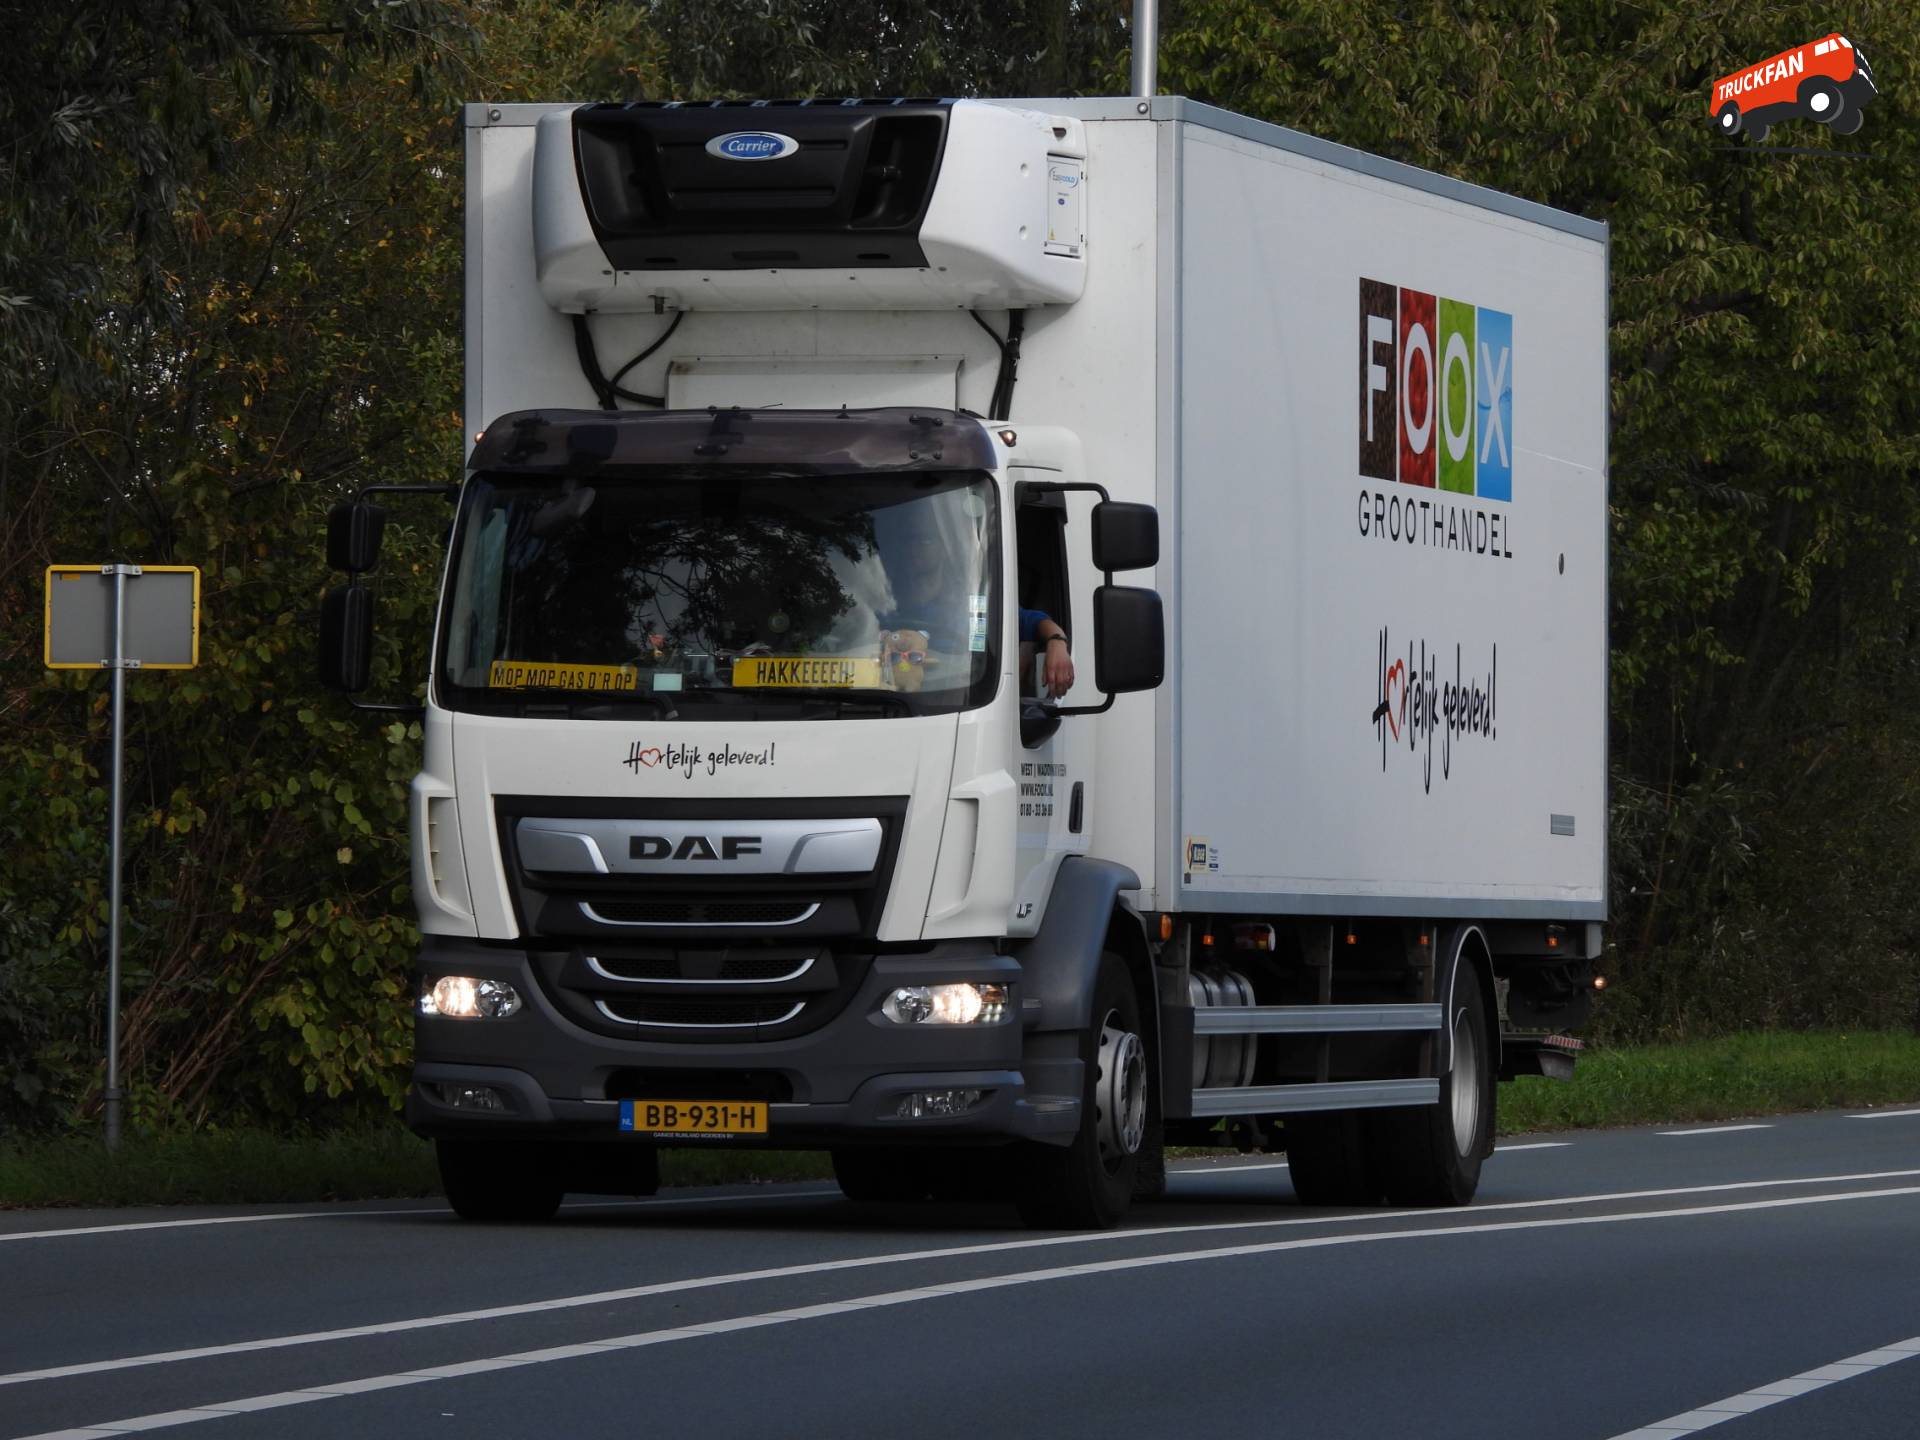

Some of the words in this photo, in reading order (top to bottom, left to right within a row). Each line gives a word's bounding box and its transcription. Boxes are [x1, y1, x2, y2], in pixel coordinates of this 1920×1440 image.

[728, 140, 776, 151] Carrier
[1367, 315, 1510, 468] FOOX
[1359, 489, 1512, 558] GROOTHANDEL
[494, 667, 522, 686] MOP
[527, 668, 555, 687] MOP
[560, 670, 584, 689] GAS
[1443, 642, 1496, 780] geleverd!
[707, 742, 775, 776] geleverd!
[629, 836, 762, 860] DAF
[1016, 903, 1032, 919] LF
[646, 1105, 755, 1128] BB-931-H
